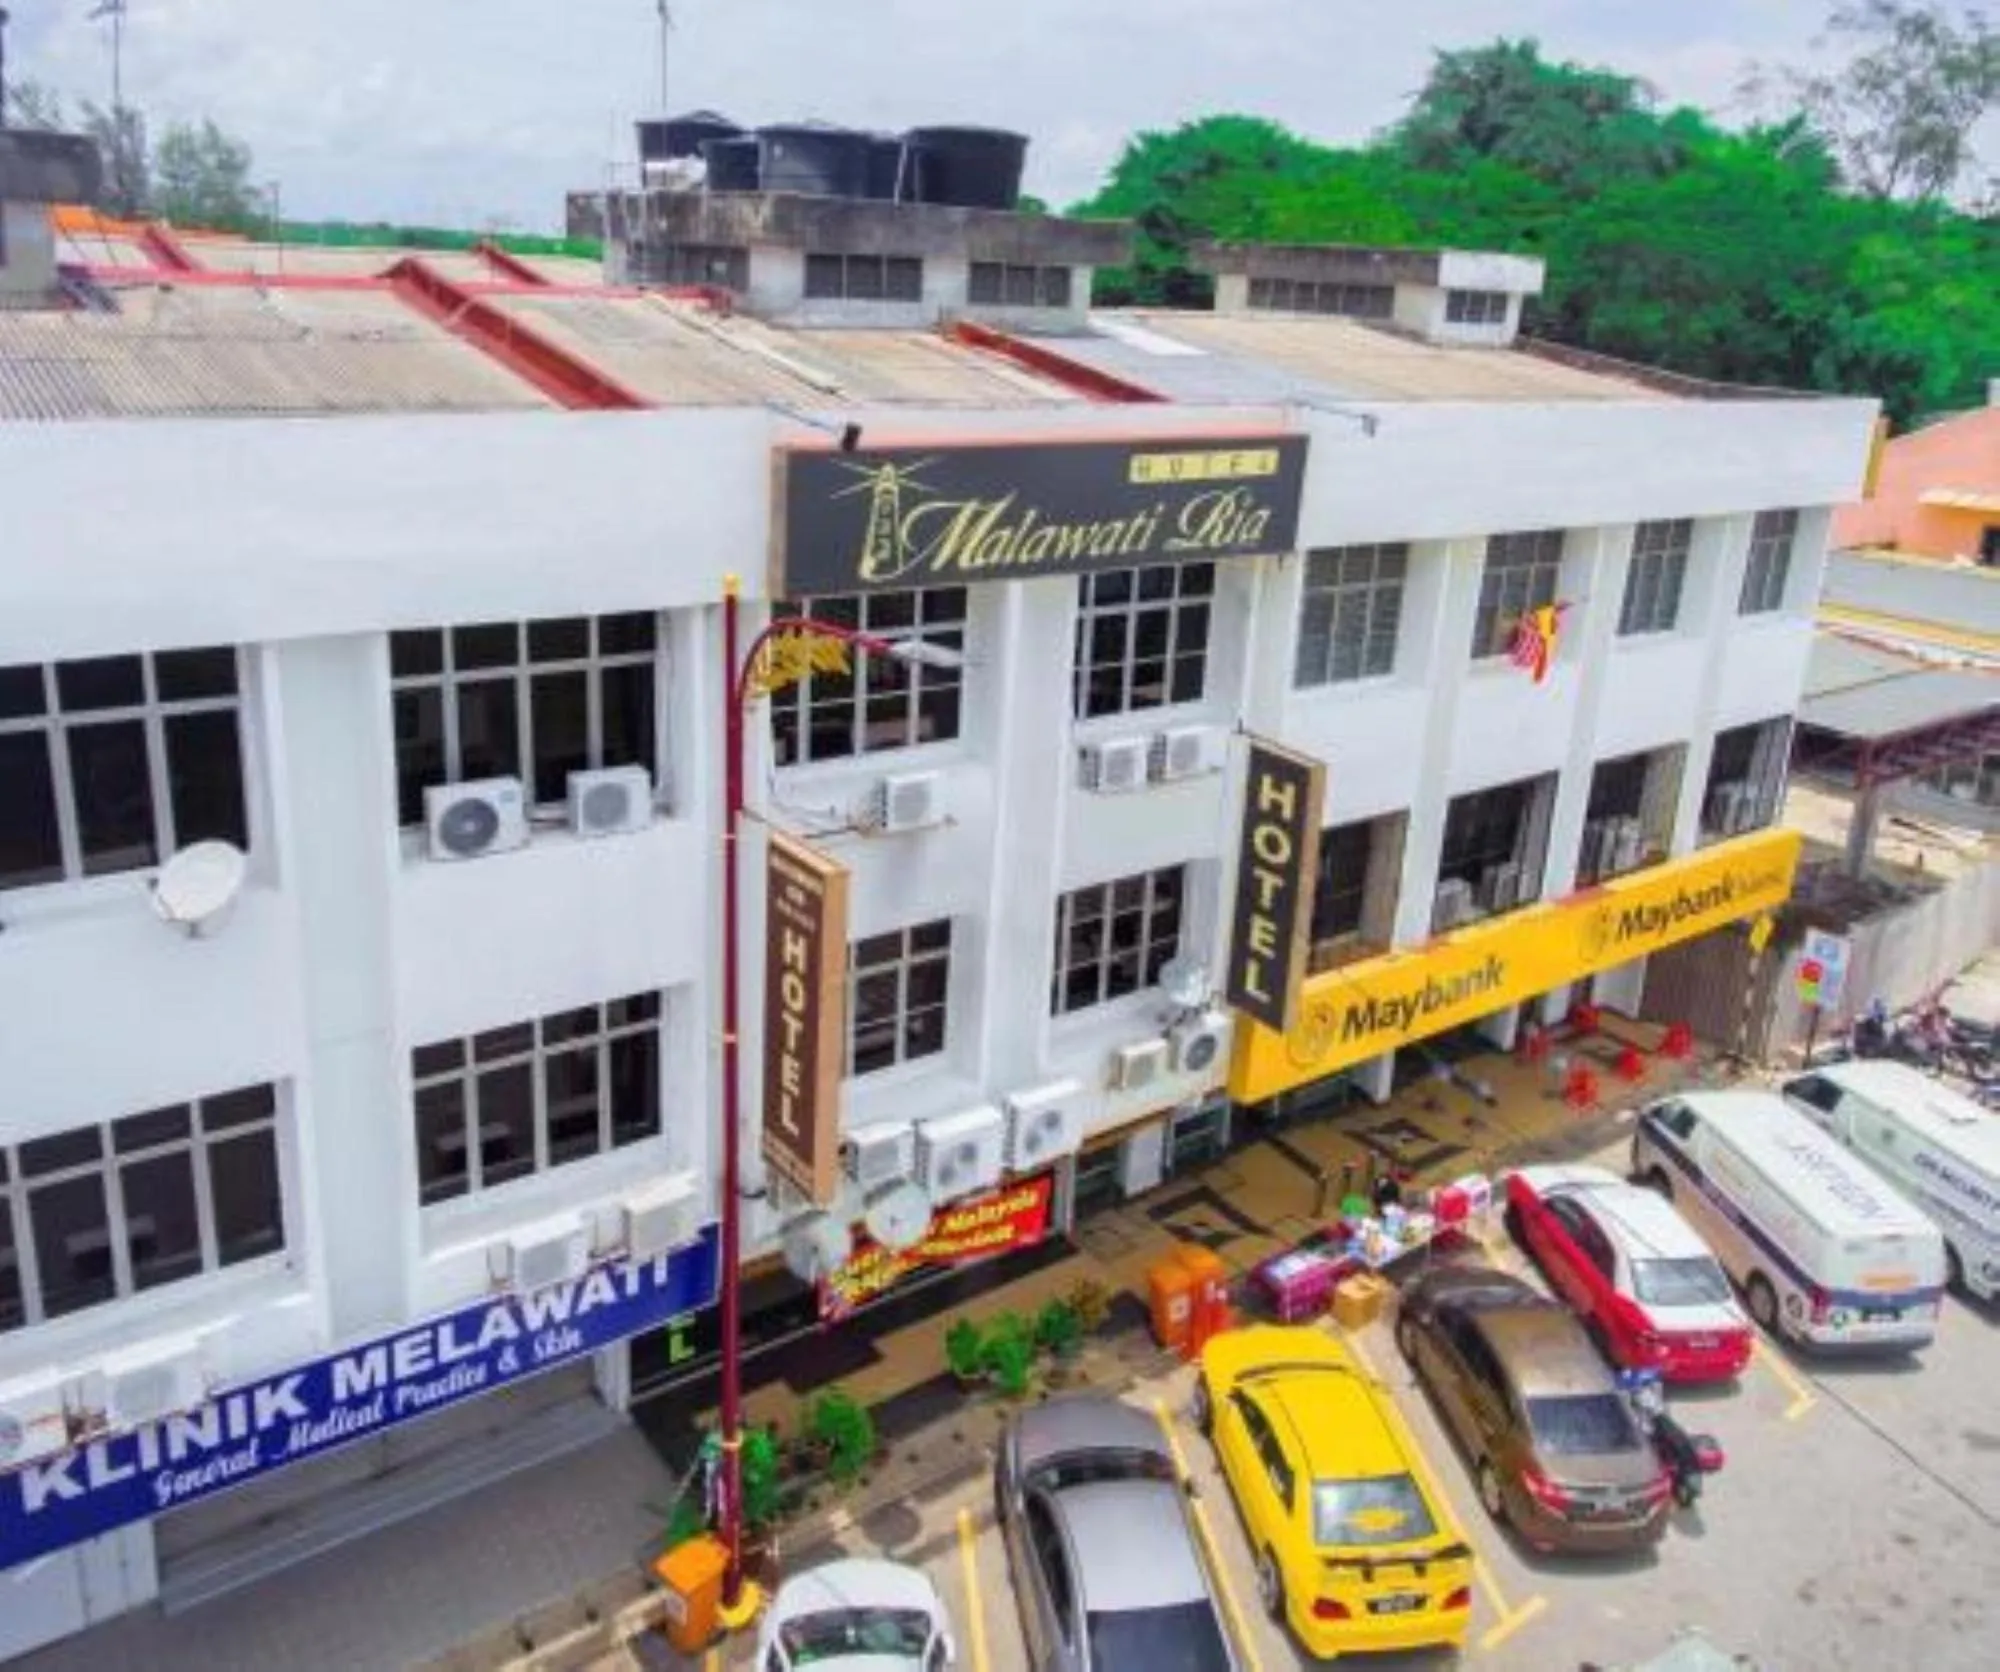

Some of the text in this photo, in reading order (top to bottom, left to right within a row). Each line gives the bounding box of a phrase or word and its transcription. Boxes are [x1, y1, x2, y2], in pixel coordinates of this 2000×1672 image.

[901, 485, 1272, 571] Malawati Ria
[1244, 772, 1297, 1005] HOTEL
[1615, 869, 1732, 942] Maybank
[780, 926, 808, 1137] HOTEL
[1341, 953, 1504, 1043] Maybank
[20, 1373, 309, 1515] KLINIK
[330, 1251, 670, 1401] MELAWATI
[153, 1325, 583, 1507] General Medical Practice & Skin
